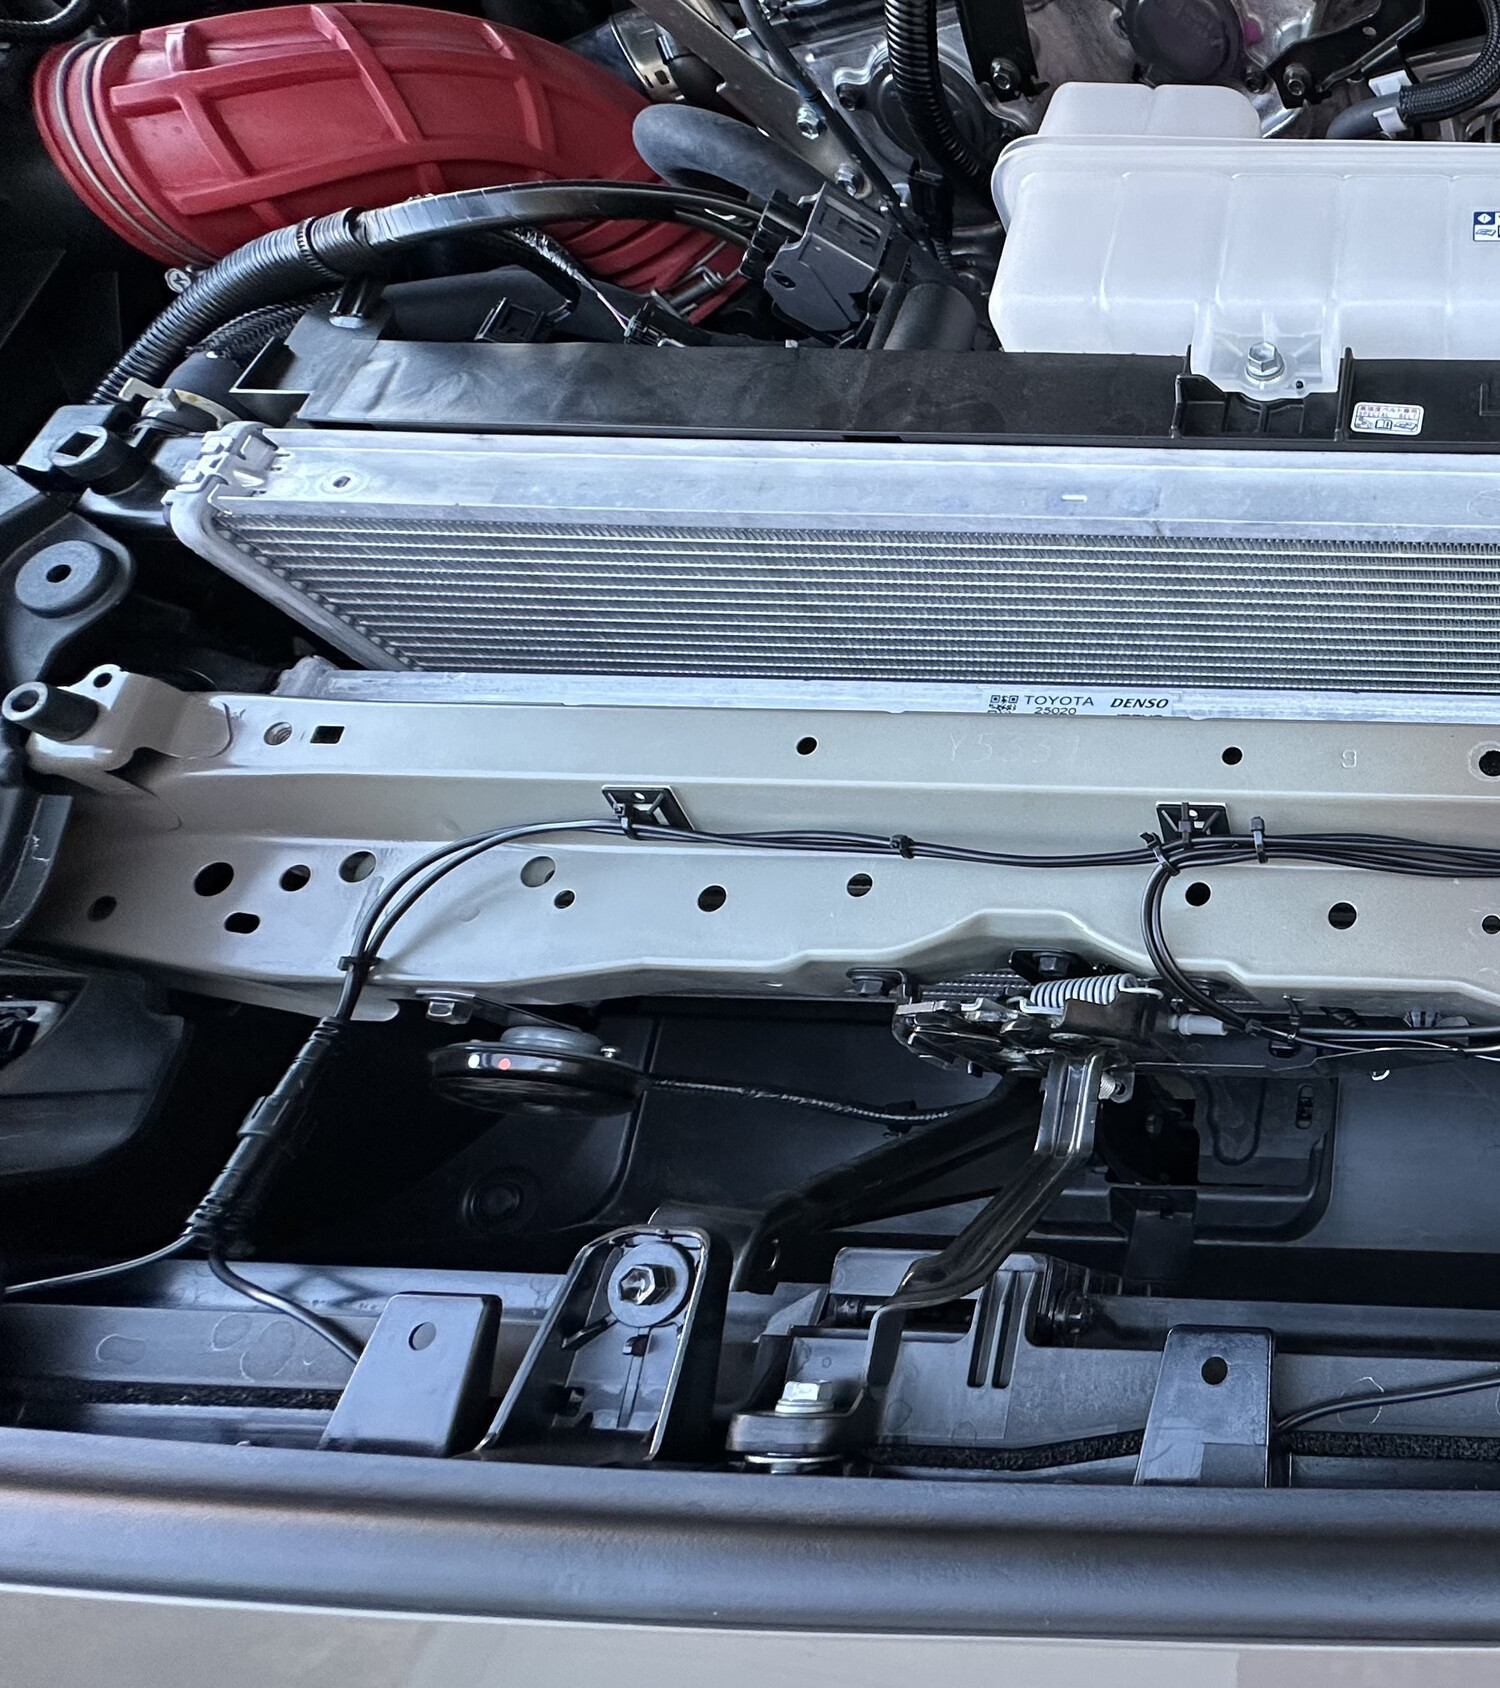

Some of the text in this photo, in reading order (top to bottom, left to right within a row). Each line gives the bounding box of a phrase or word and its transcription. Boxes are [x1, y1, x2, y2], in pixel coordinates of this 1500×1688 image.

[1024, 695, 1169, 709] TOYOTA DENSO
[1034, 706, 1077, 715] 25020
